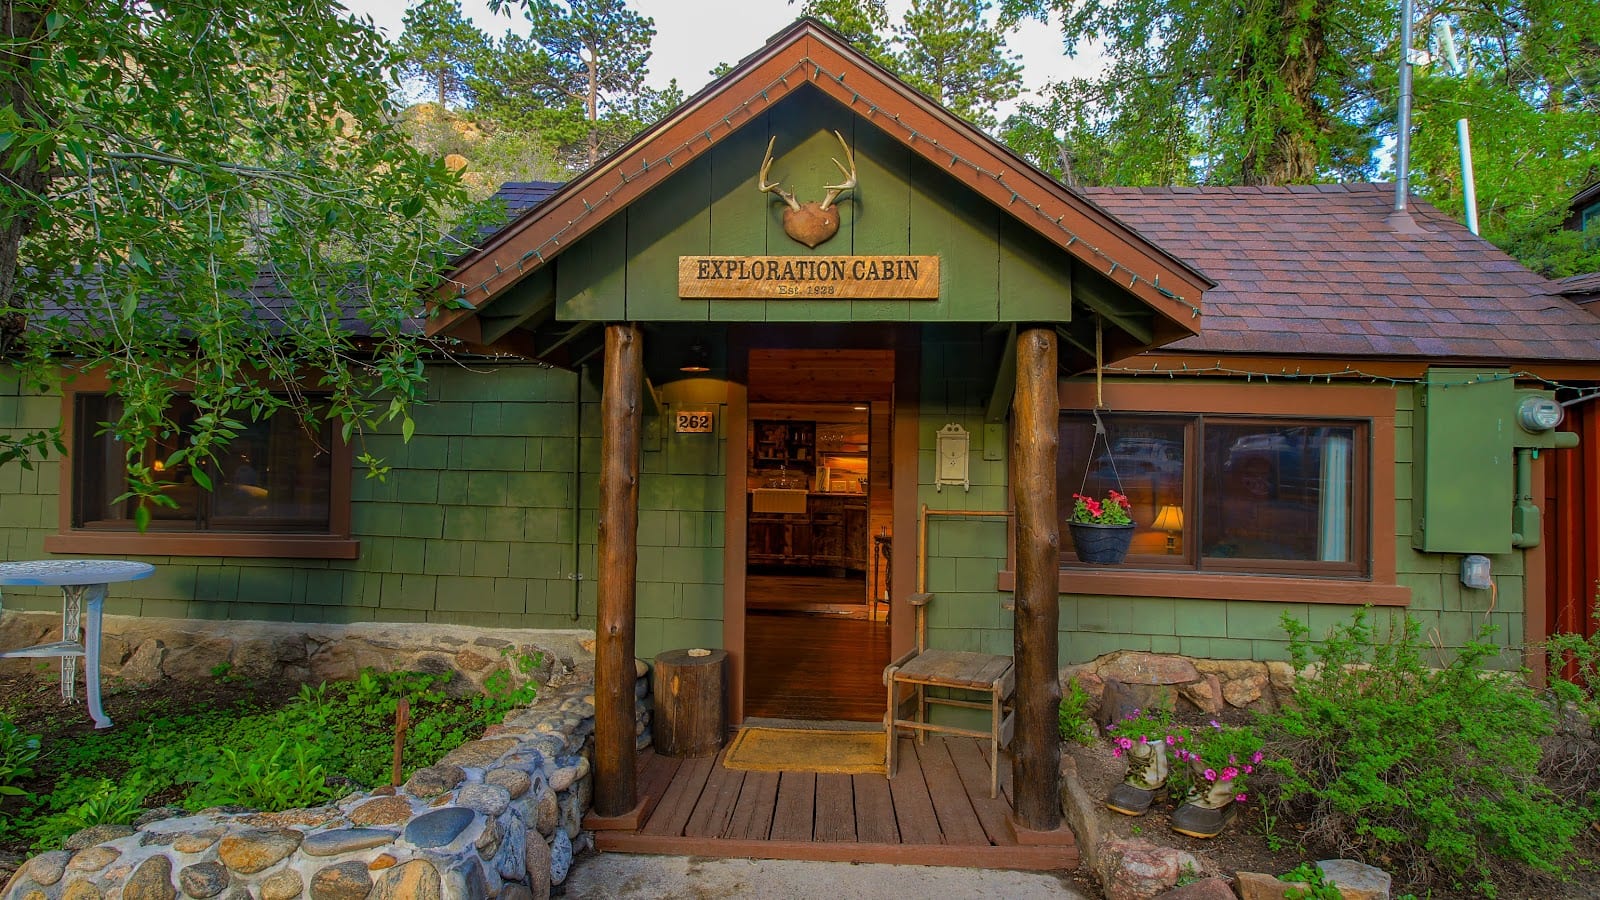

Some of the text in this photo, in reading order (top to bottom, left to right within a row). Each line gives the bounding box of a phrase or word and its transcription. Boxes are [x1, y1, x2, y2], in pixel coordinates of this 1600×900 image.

[697, 260, 919, 281] EXPLORATION CABIN
[807, 285, 835, 295] 1928
[679, 415, 709, 428] 262
